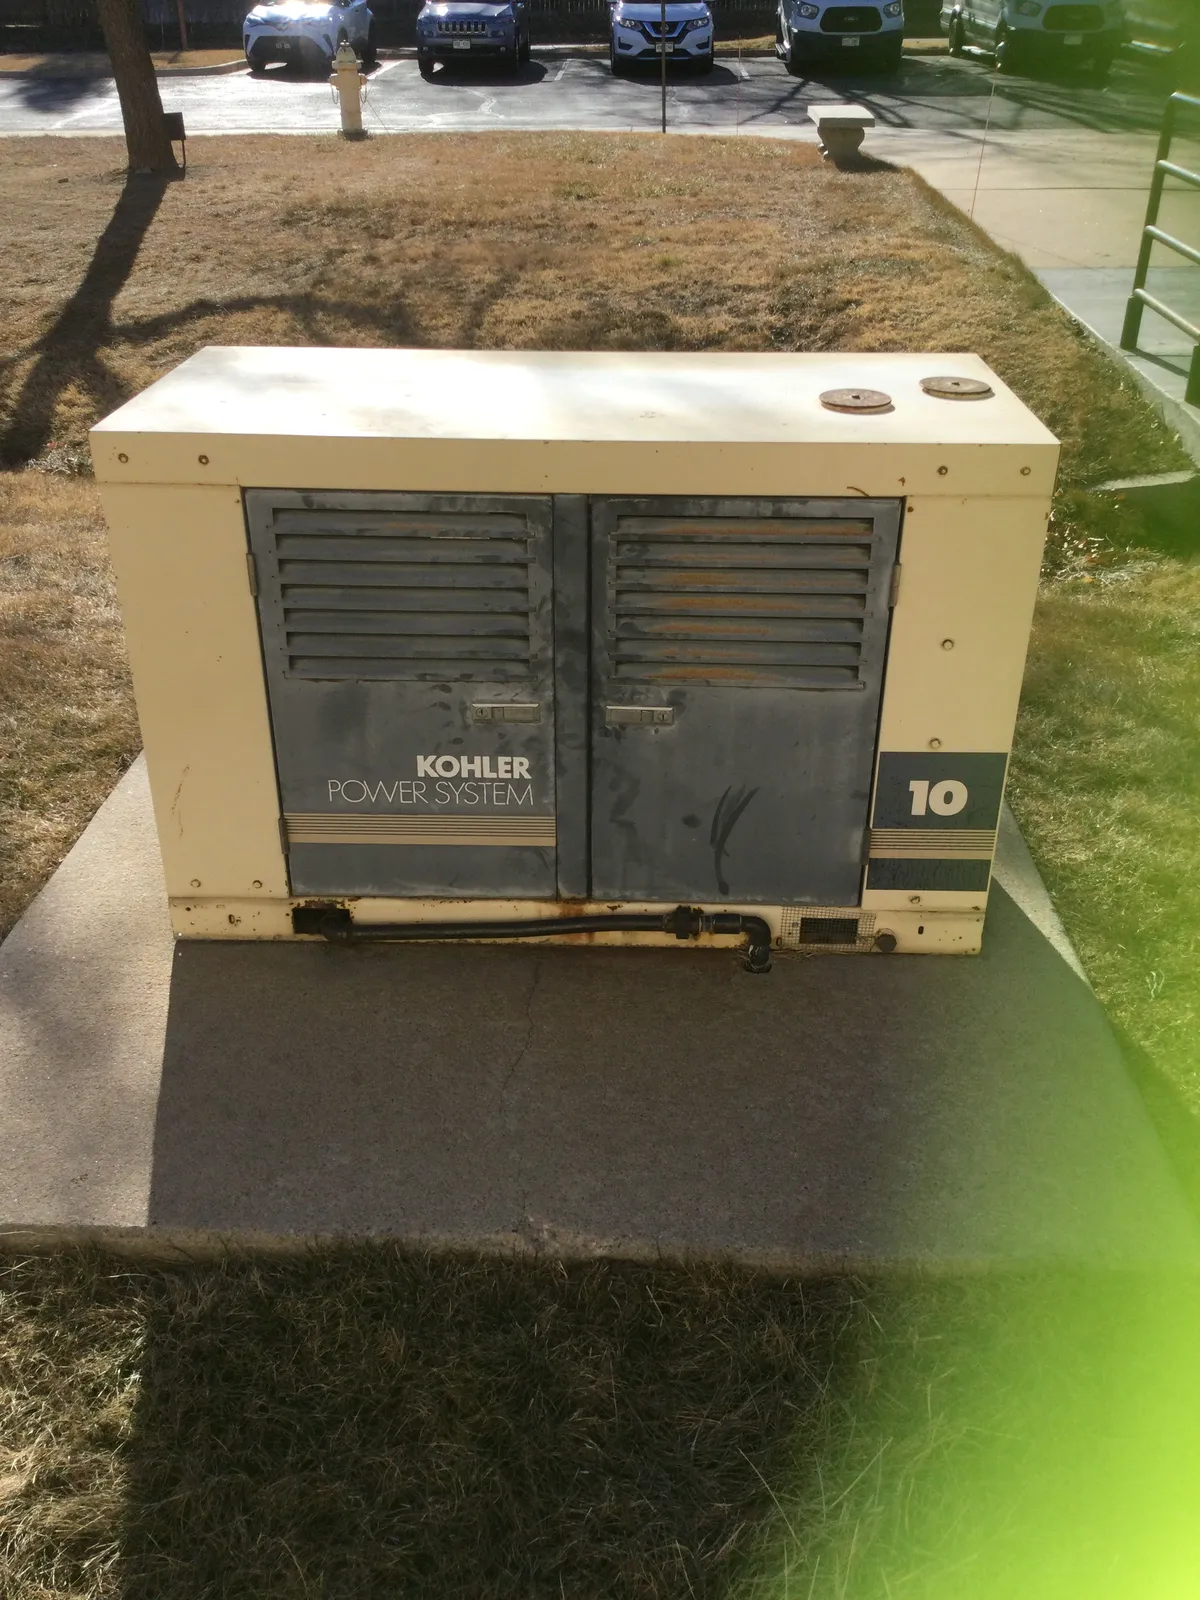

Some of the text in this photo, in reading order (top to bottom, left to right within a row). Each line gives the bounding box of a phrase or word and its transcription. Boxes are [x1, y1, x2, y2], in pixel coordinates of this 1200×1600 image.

[416, 754, 533, 780] KOHLER
[327, 779, 535, 806] POWER SYSTEM
[908, 779, 968, 817] 10
